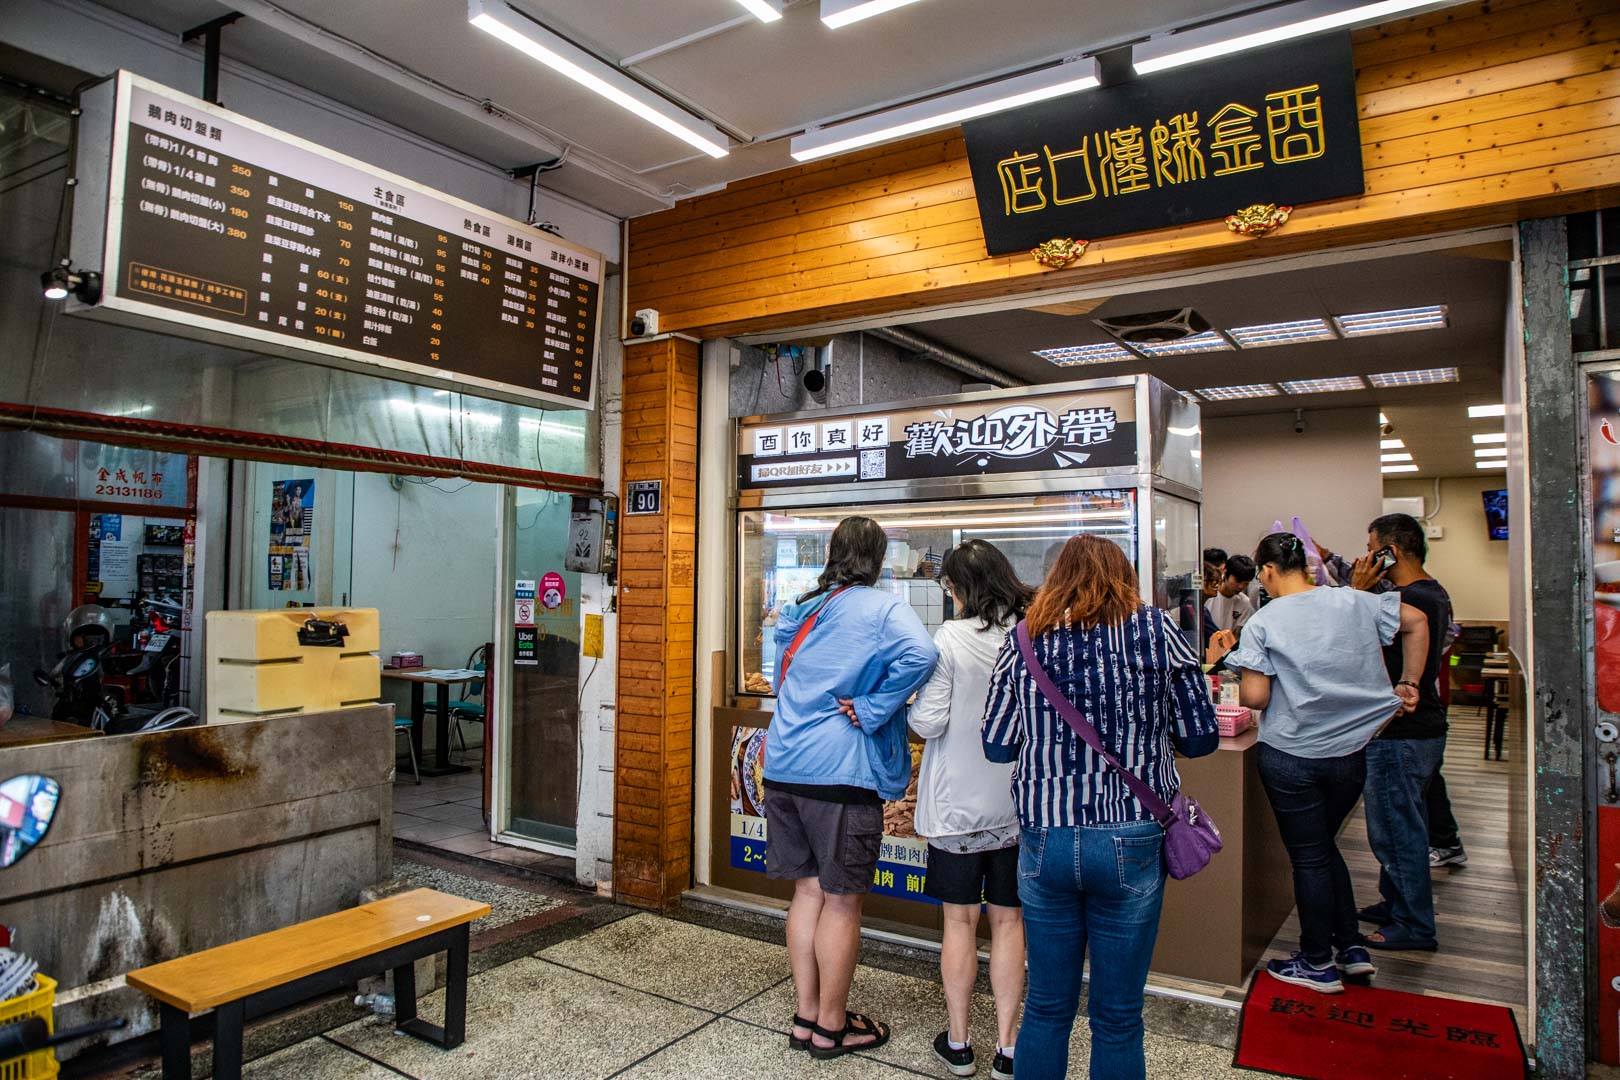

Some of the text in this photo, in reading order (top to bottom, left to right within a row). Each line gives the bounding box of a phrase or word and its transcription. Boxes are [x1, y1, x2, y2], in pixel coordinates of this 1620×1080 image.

[231, 164, 252, 177] 350
[230, 185, 250, 198] 350
[338, 201, 354, 212] 150
[229, 207, 249, 219] 180
[336, 220, 353, 231] 130
[227, 227, 247, 240] 380
[340, 239, 352, 249] 70
[482, 250, 492, 259] 70
[338, 257, 350, 267] 70
[481, 263, 491, 271] 50
[480, 277, 490, 285] 40
[433, 293, 444, 302] 55
[432, 308, 443, 317] 40
[431, 323, 442, 331] 40
[430, 338, 441, 346] 20
[96, 466, 164, 487] 金成帆布
[757, 463, 823, 479] 掃QR加好友
[95, 484, 164, 500] 23131186
[637, 493, 656, 510] 90
[518, 632, 534, 642] Uber
[518, 641, 534, 649] Eats
[741, 821, 764, 838] 1/4
[744, 845, 768, 865] 2~
[906, 873, 926, 894] 前
[1269, 996, 1500, 1048] 歡迎光臨
